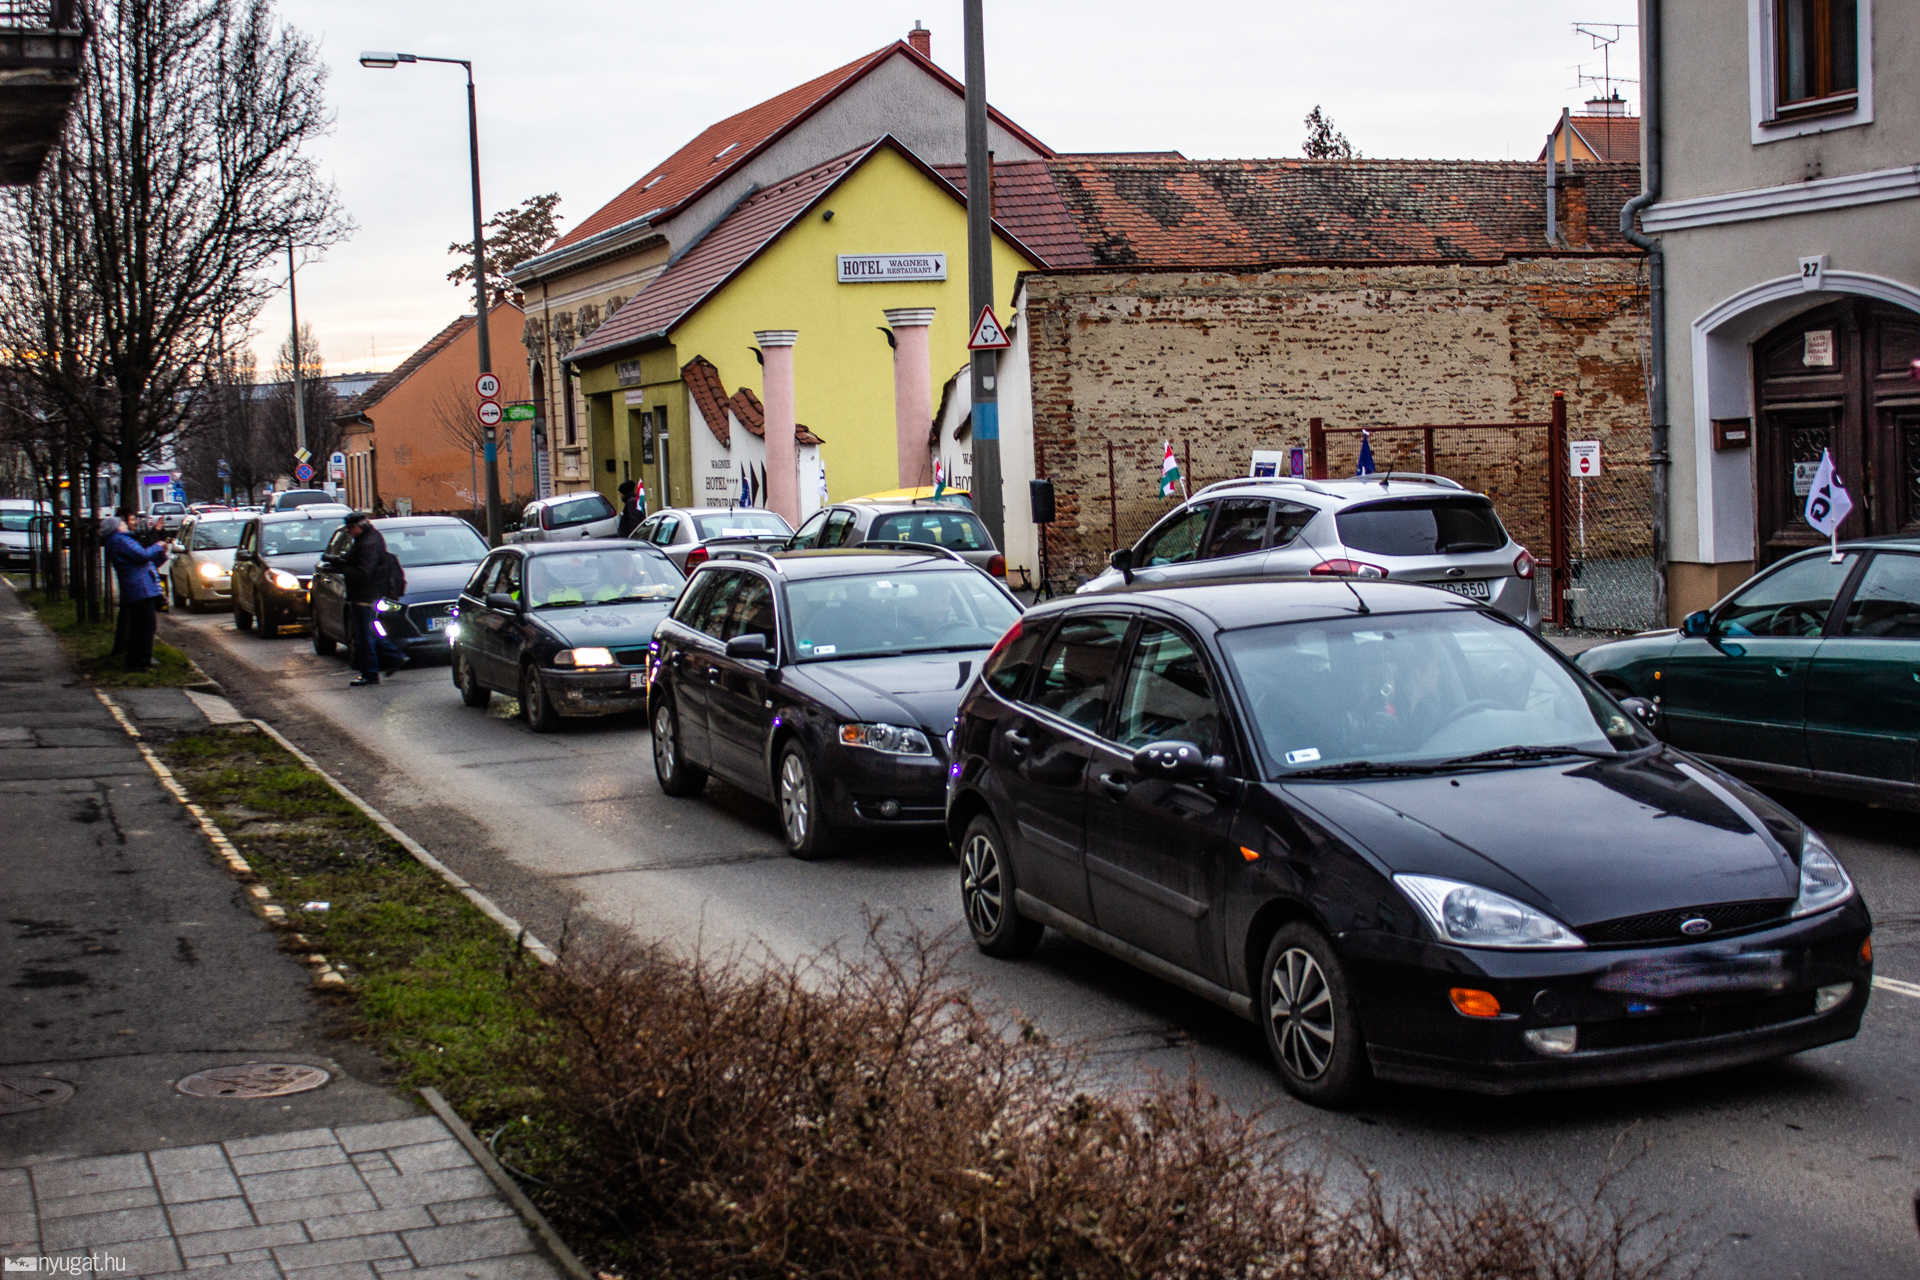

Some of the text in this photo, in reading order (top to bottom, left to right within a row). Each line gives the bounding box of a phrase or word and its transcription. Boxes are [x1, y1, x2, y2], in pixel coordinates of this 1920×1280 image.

[843, 260, 884, 275] HOTEL
[889, 259, 929, 267] WAGNER
[1803, 262, 1819, 277] 27
[481, 381, 495, 391] 40
[705, 476, 727, 490] HOTEL
